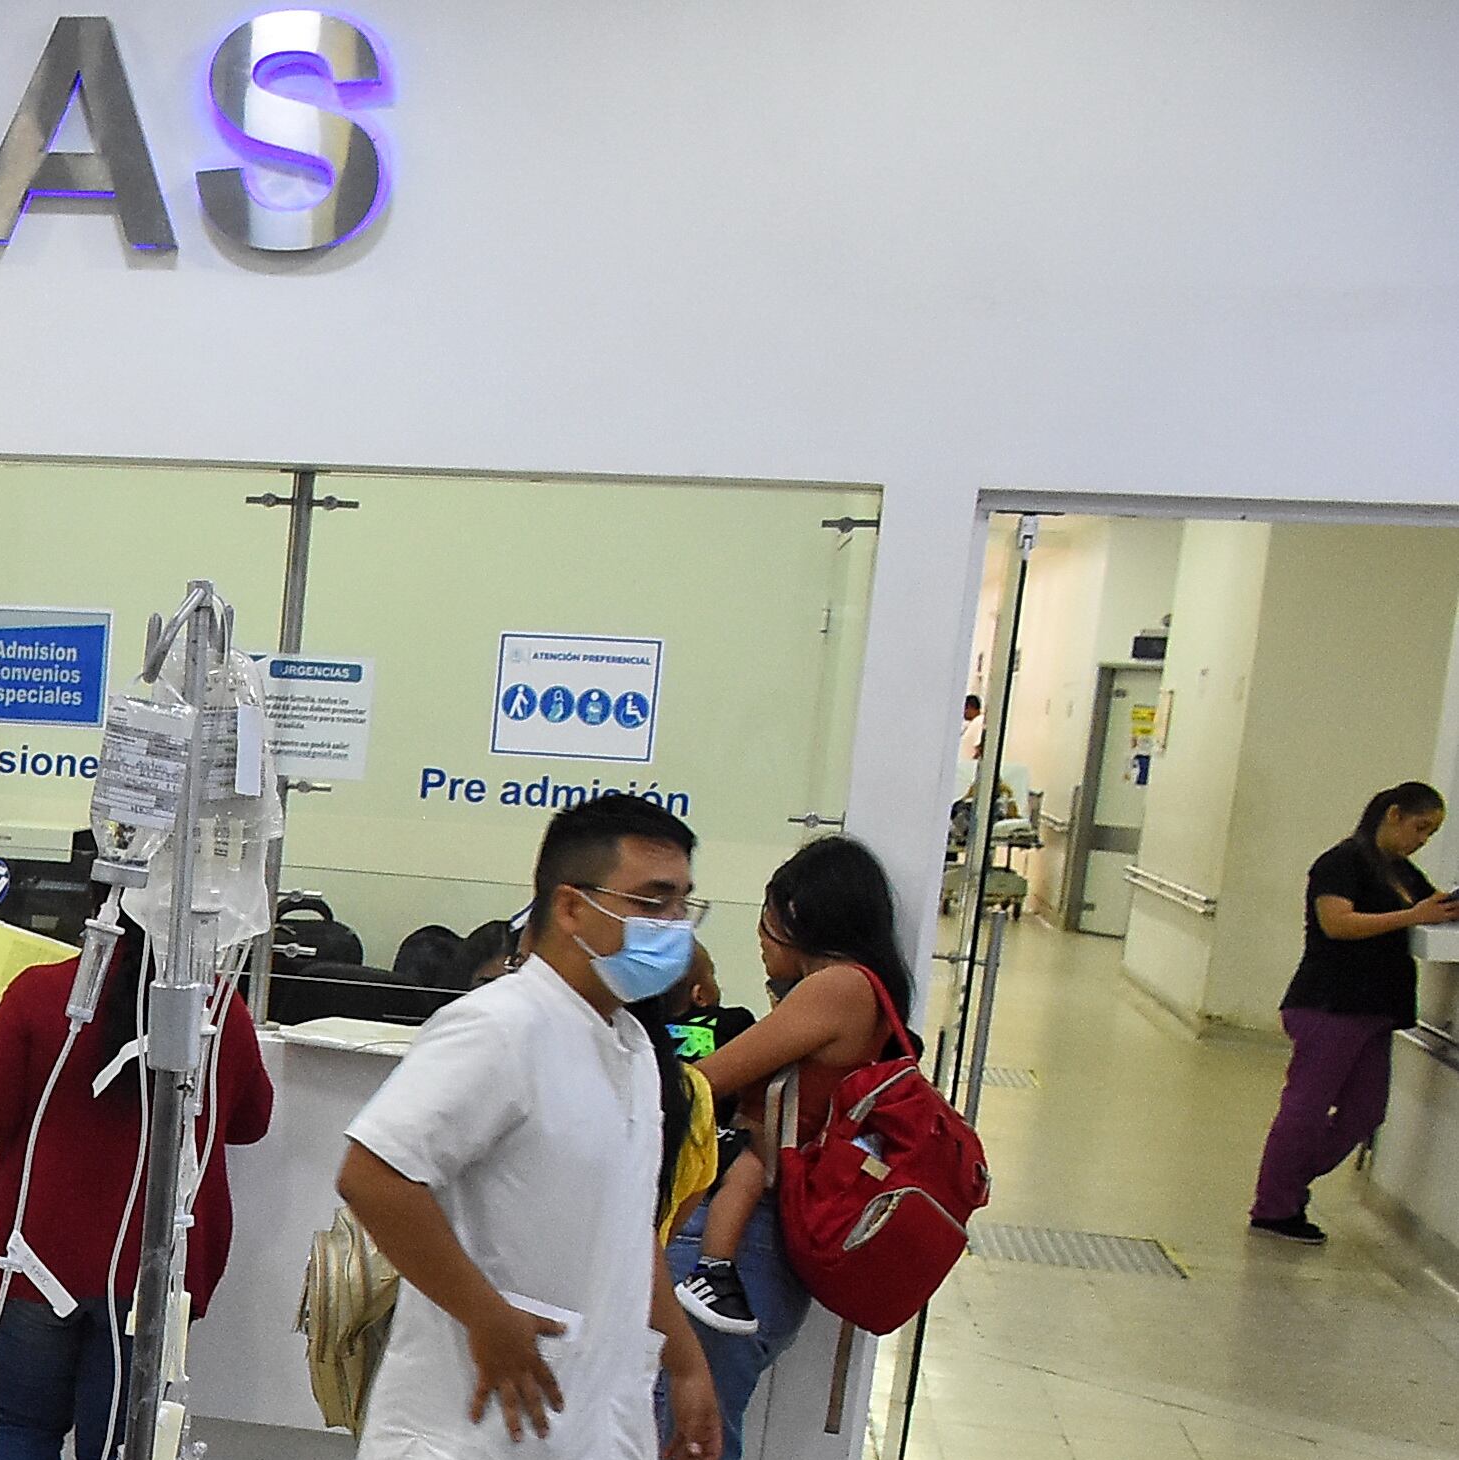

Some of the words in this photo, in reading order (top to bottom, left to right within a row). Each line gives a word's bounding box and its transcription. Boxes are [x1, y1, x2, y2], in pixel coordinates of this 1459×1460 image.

[532, 651, 581, 662] ATENCIÓN
[582, 653, 651, 666] PREFERENCIAL
[419, 768, 487, 803] Pre
